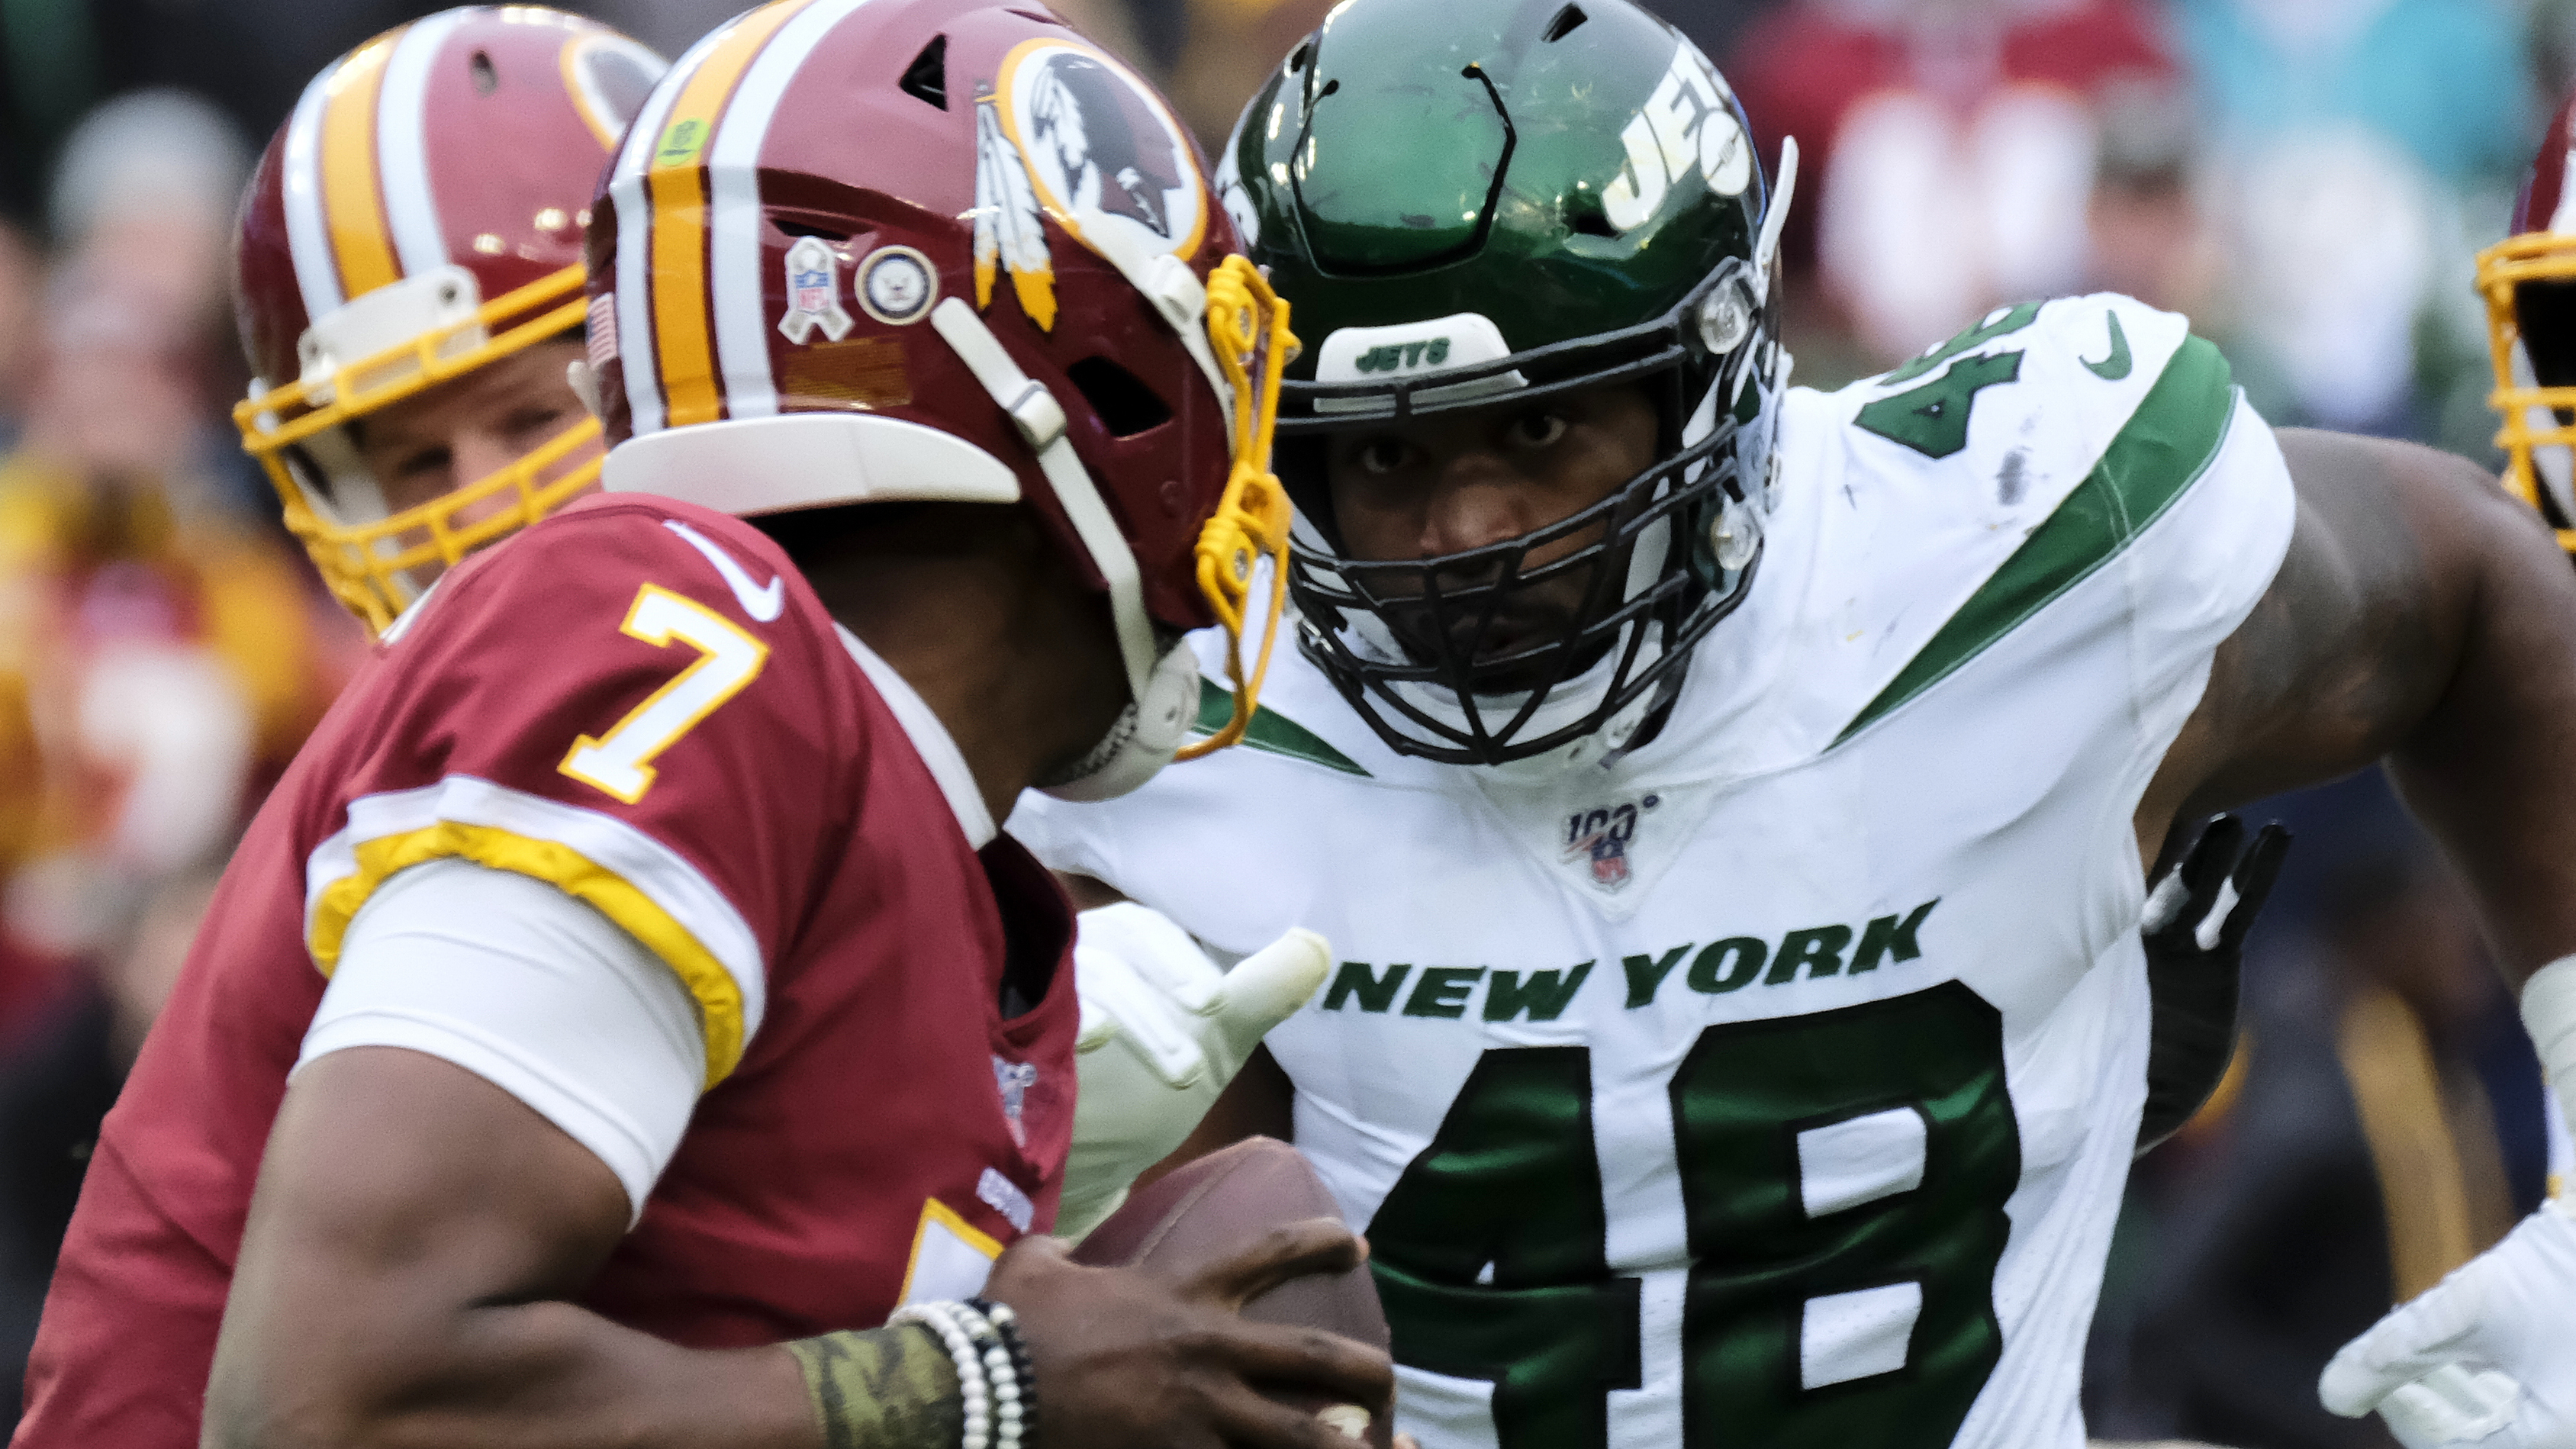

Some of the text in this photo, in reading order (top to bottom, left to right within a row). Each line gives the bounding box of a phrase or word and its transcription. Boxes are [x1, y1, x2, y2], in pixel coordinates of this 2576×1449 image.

[1356, 337, 1451, 373] JETS
[558, 580, 771, 804] 7
[1323, 897, 1940, 1021] NEW YORK
[1366, 979, 2021, 1449] 48
